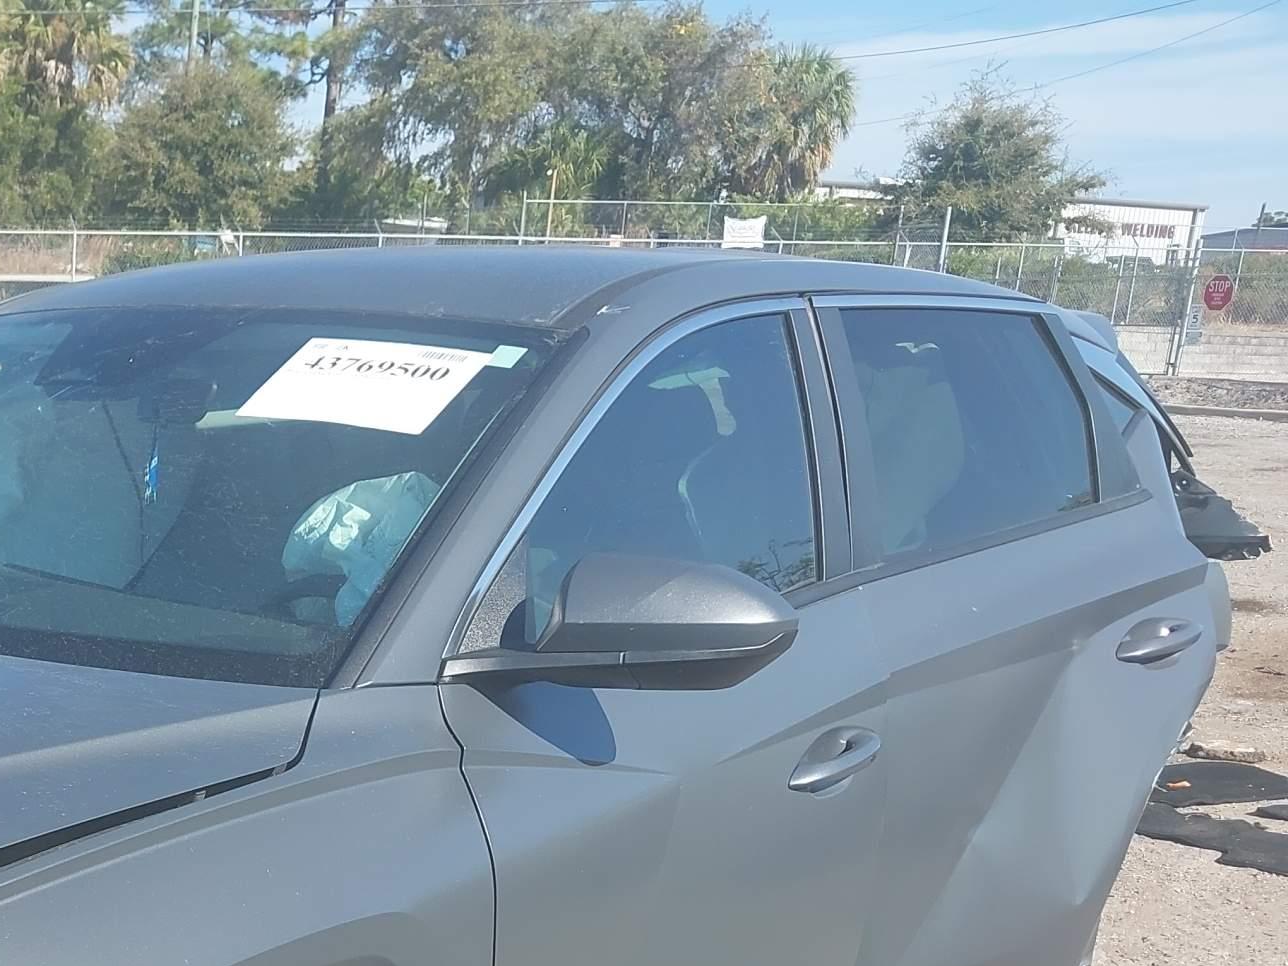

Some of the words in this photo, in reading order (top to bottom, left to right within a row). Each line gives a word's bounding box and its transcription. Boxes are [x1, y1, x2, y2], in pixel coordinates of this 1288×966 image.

[1121, 223, 1175, 239] WELDING
[1208, 280, 1231, 292] STOP
[1192, 314, 1199, 324] 5
[304, 356, 450, 381] 43769500
